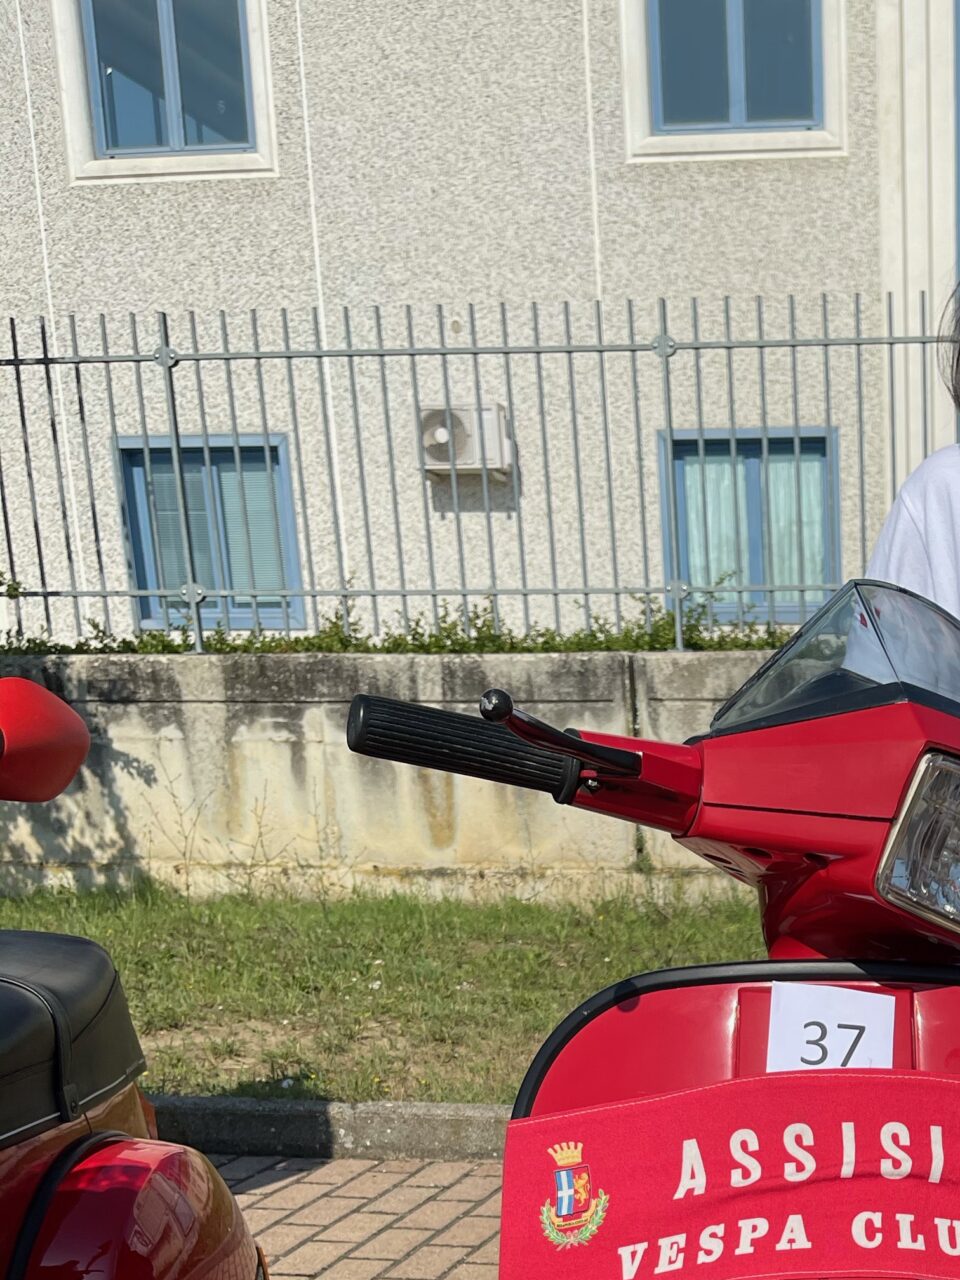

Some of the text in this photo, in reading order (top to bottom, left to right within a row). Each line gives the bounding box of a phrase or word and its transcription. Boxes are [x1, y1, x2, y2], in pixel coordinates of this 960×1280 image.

[800, 1020, 866, 1067] 37
[672, 1121, 945, 1200] ASSISI
[617, 1213, 812, 1280] VESPA
